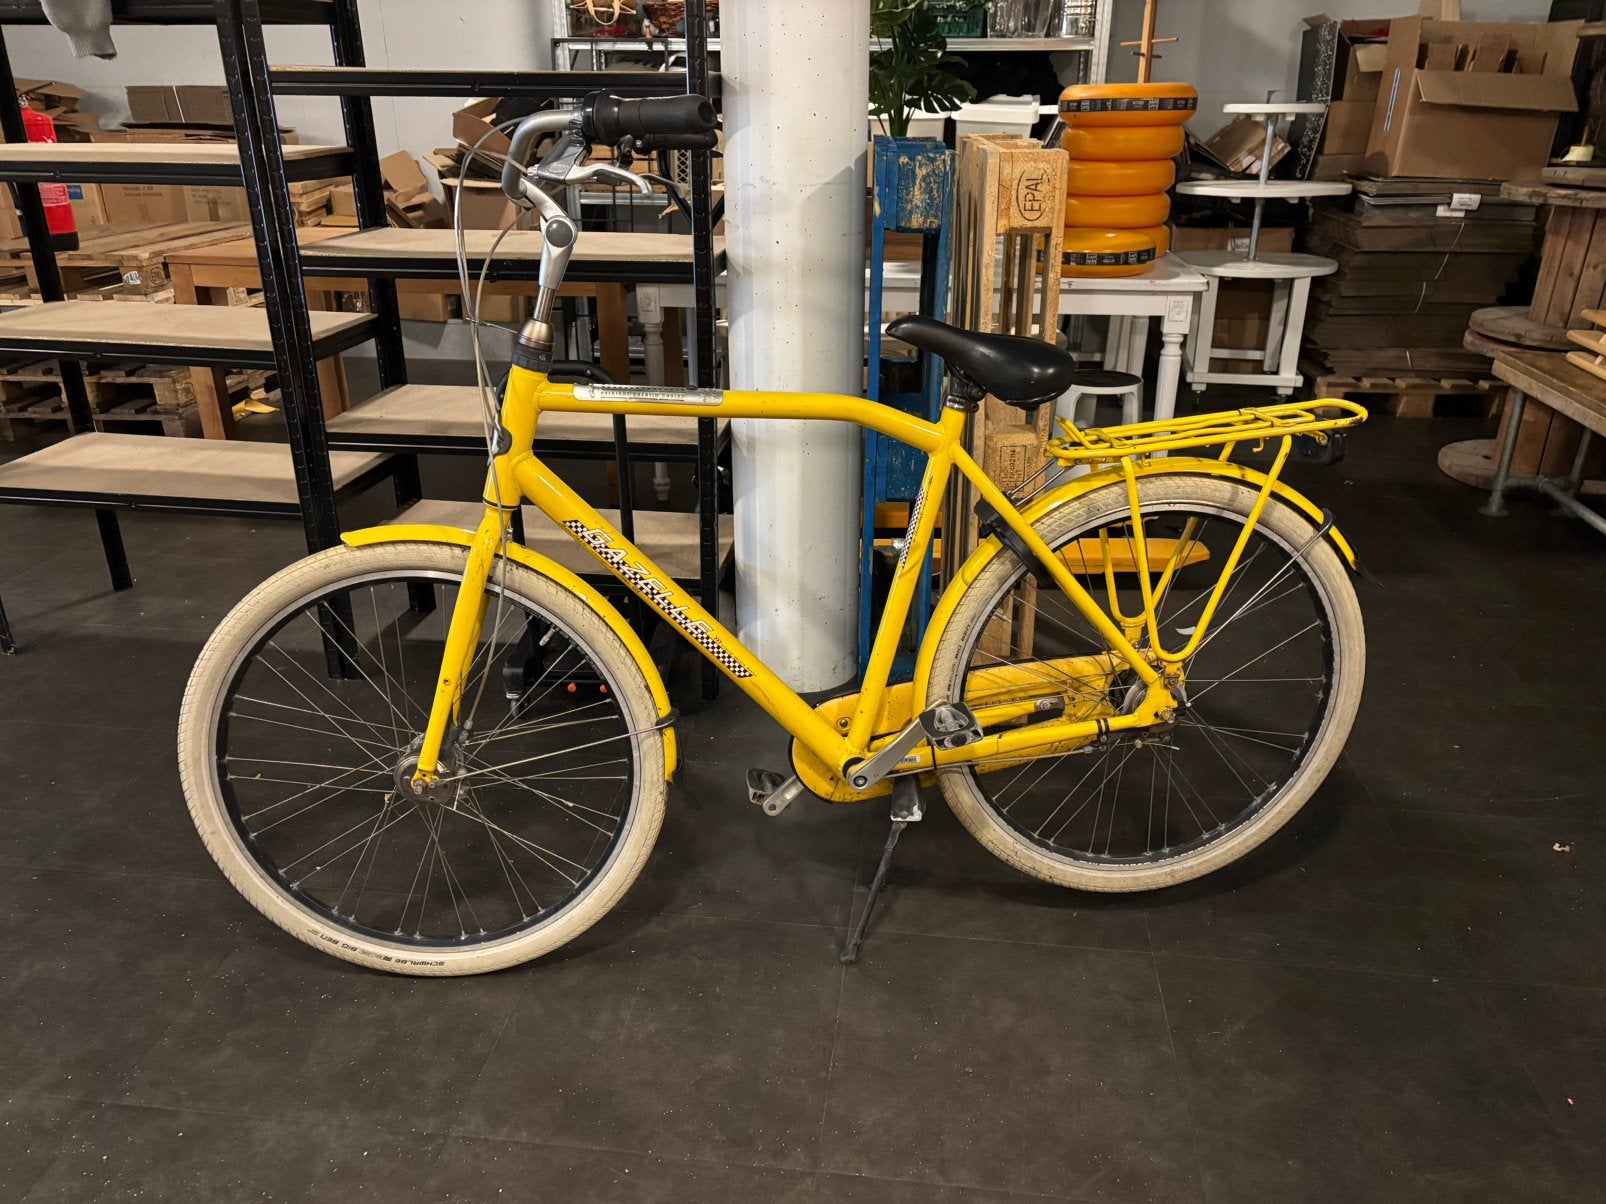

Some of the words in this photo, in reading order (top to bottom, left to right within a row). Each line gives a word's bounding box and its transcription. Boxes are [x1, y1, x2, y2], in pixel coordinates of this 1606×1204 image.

[1024, 173, 1043, 211] EPAL
[583, 528, 713, 635] GAZELLE
[320, 934, 340, 945] BEN
[341, 943, 359, 952] BIG
[394, 958, 446, 967] SCHWALBE
